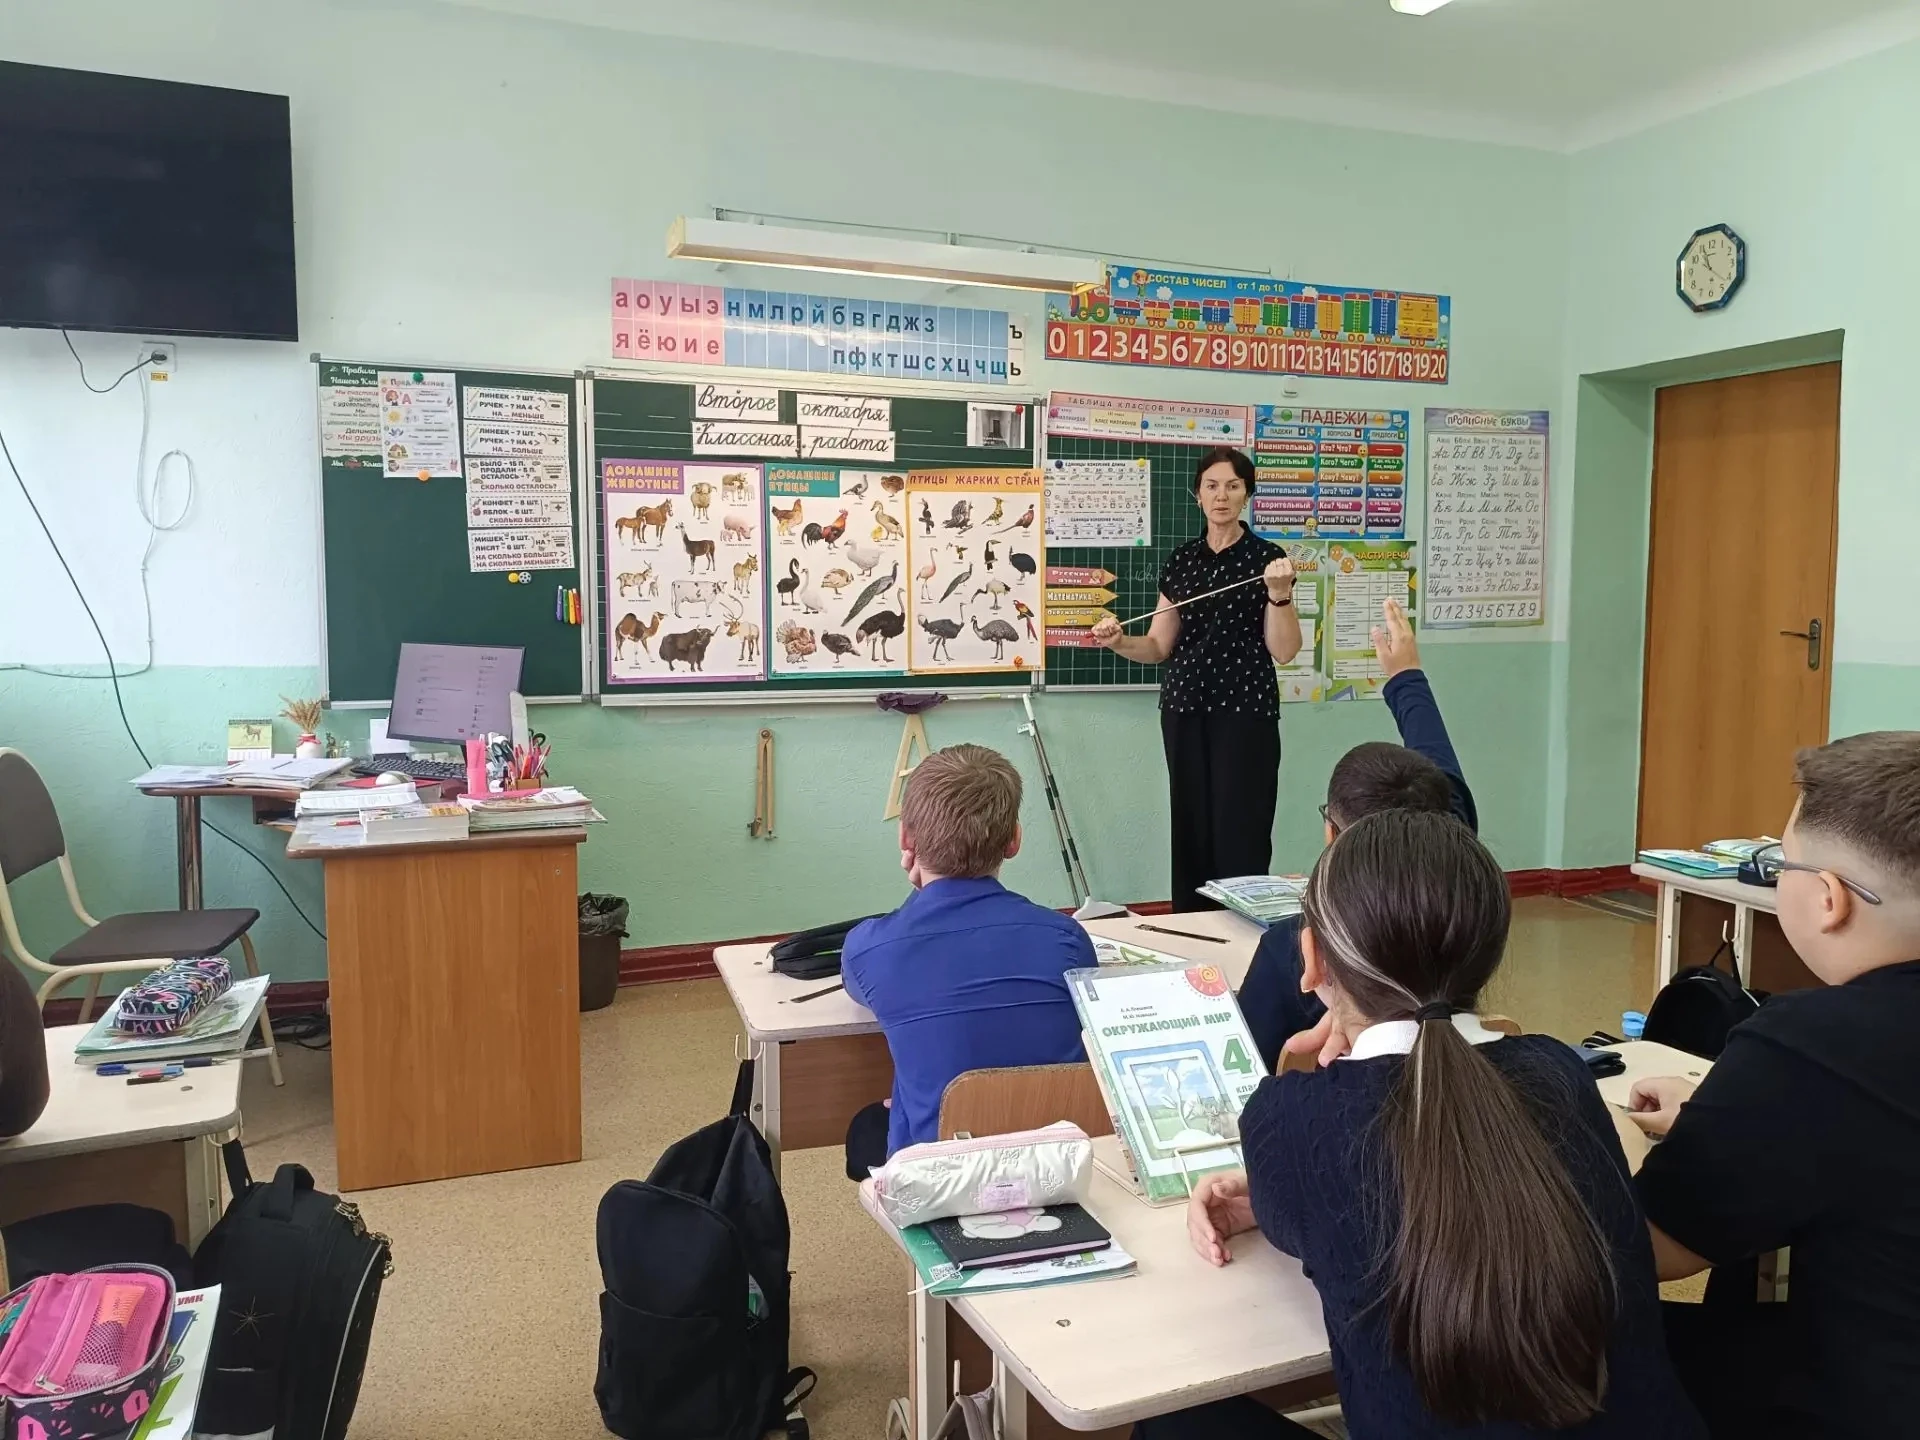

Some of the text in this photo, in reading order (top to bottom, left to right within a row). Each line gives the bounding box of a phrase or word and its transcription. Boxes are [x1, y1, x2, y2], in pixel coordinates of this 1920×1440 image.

[1709, 240, 1716, 249] 12
[1149, 274, 1227, 289] СОСТАВ ЧИСЕЛ
[1274, 284, 1284, 292] 10
[1050, 328, 1446, 379] 0 1 2 3 4 5 6 7 8 9 10 11 12 13 14 15 16 17 18 19 20
[342, 366, 376, 376] Правила
[699, 386, 776, 417] Второе
[1069, 397, 1112, 407] ТАБЛИЦА
[1117, 403, 1164, 411] КЛАССОВ
[1181, 407, 1230, 416] РАЗРЯДОВ
[1301, 410, 1367, 425] ПАДЕЖИ
[1448, 415, 1529, 426] ПРОПИСНЫЕ БУКВЫ
[697, 424, 889, 457] Классная работа
[1258, 443, 1314, 451] Именительный
[1258, 457, 1308, 465] Родительный
[606, 465, 679, 477] ДОМАШНИЕ
[769, 470, 835, 481] ДОМАШНИЕ
[1258, 472, 1299, 480] Дательный
[607, 479, 679, 490] ЖИВОТНЫЕ
[910, 476, 948, 485] ПТИЦЫ
[956, 476, 1000, 485] ЖАРКИХ
[1006, 476, 1040, 486] СТРАН
[769, 481, 809, 493] ПТИЦЫ
[1257, 501, 1311, 509] Творительный
[1356, 551, 1410, 560] ЧАСТИ РЕЧИ
[1102, 1012, 1232, 1037] ОКРУЖАЮЩИЙ МИР
[1223, 1038, 1252, 1074] 4
[177, 1294, 204, 1305] УМК
